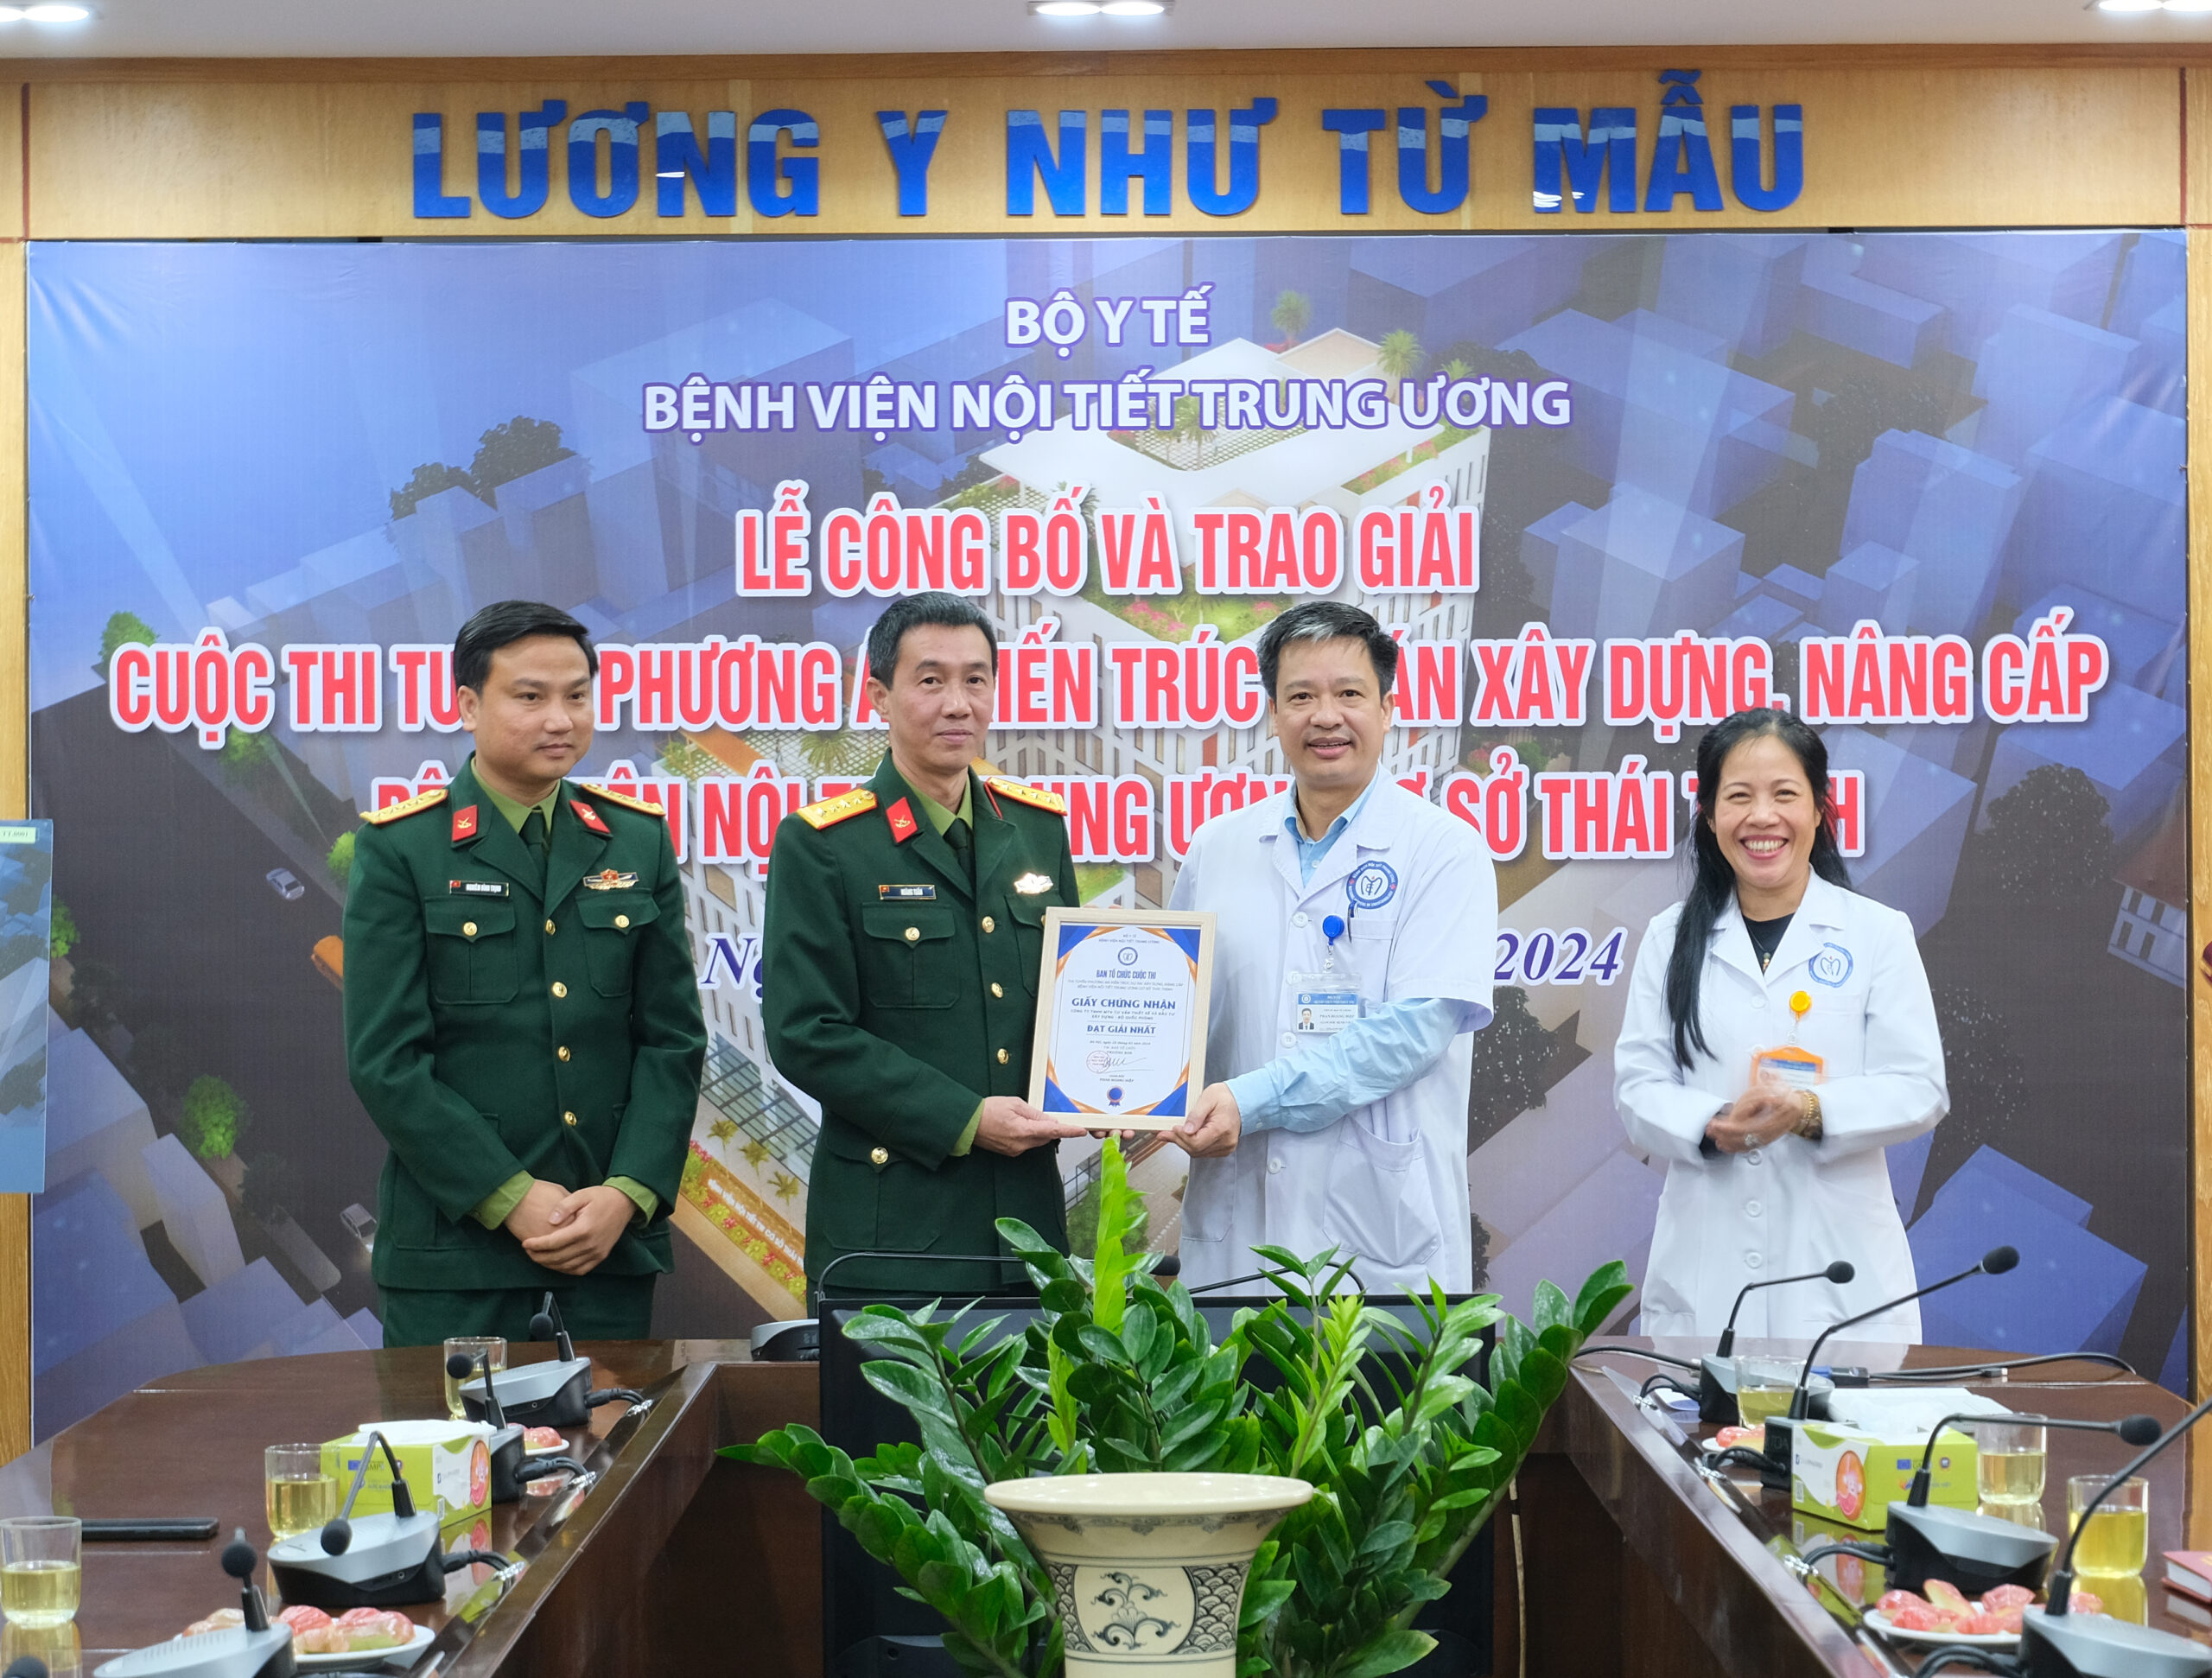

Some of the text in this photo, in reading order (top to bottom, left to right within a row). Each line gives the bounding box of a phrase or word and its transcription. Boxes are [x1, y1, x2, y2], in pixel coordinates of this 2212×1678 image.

[412, 69, 1803, 218] LƯƠNG Y NHƯ TỪ MẪU
[1006, 284, 1213, 357] BỘ Y TẾ
[645, 367, 1572, 444] BỆNH VIỆN NỘI TIẾT TRUNG ƯƠNG
[742, 484, 1474, 592] LỄ CÔNG BỐ VÀ TRAO GIẢI
[115, 634, 270, 742] CUỘC
[288, 650, 378, 725] THI
[599, 641, 835, 725] PHƯƠNG
[990, 623, 1091, 722] IẾN
[1112, 631, 1259, 722] TRÚC
[1477, 636, 1589, 720] XÂY
[1807, 626, 1967, 717] NÂNG
[1988, 613, 2103, 716] CẤP
[1540, 761, 1668, 853] THÁI
[1096, 969, 1108, 978] BAN
[1116, 969, 1131, 979] CHỨC
[1132, 969, 1147, 980] CUỘC
[1147, 971, 1156, 980] THI
[1493, 932, 1623, 981] 2024
[1071, 995, 1176, 1011] GIẤY CHỨNG NHẬN
[1087, 1023, 1156, 1034] ĐẠT GIẢI NHẤT
